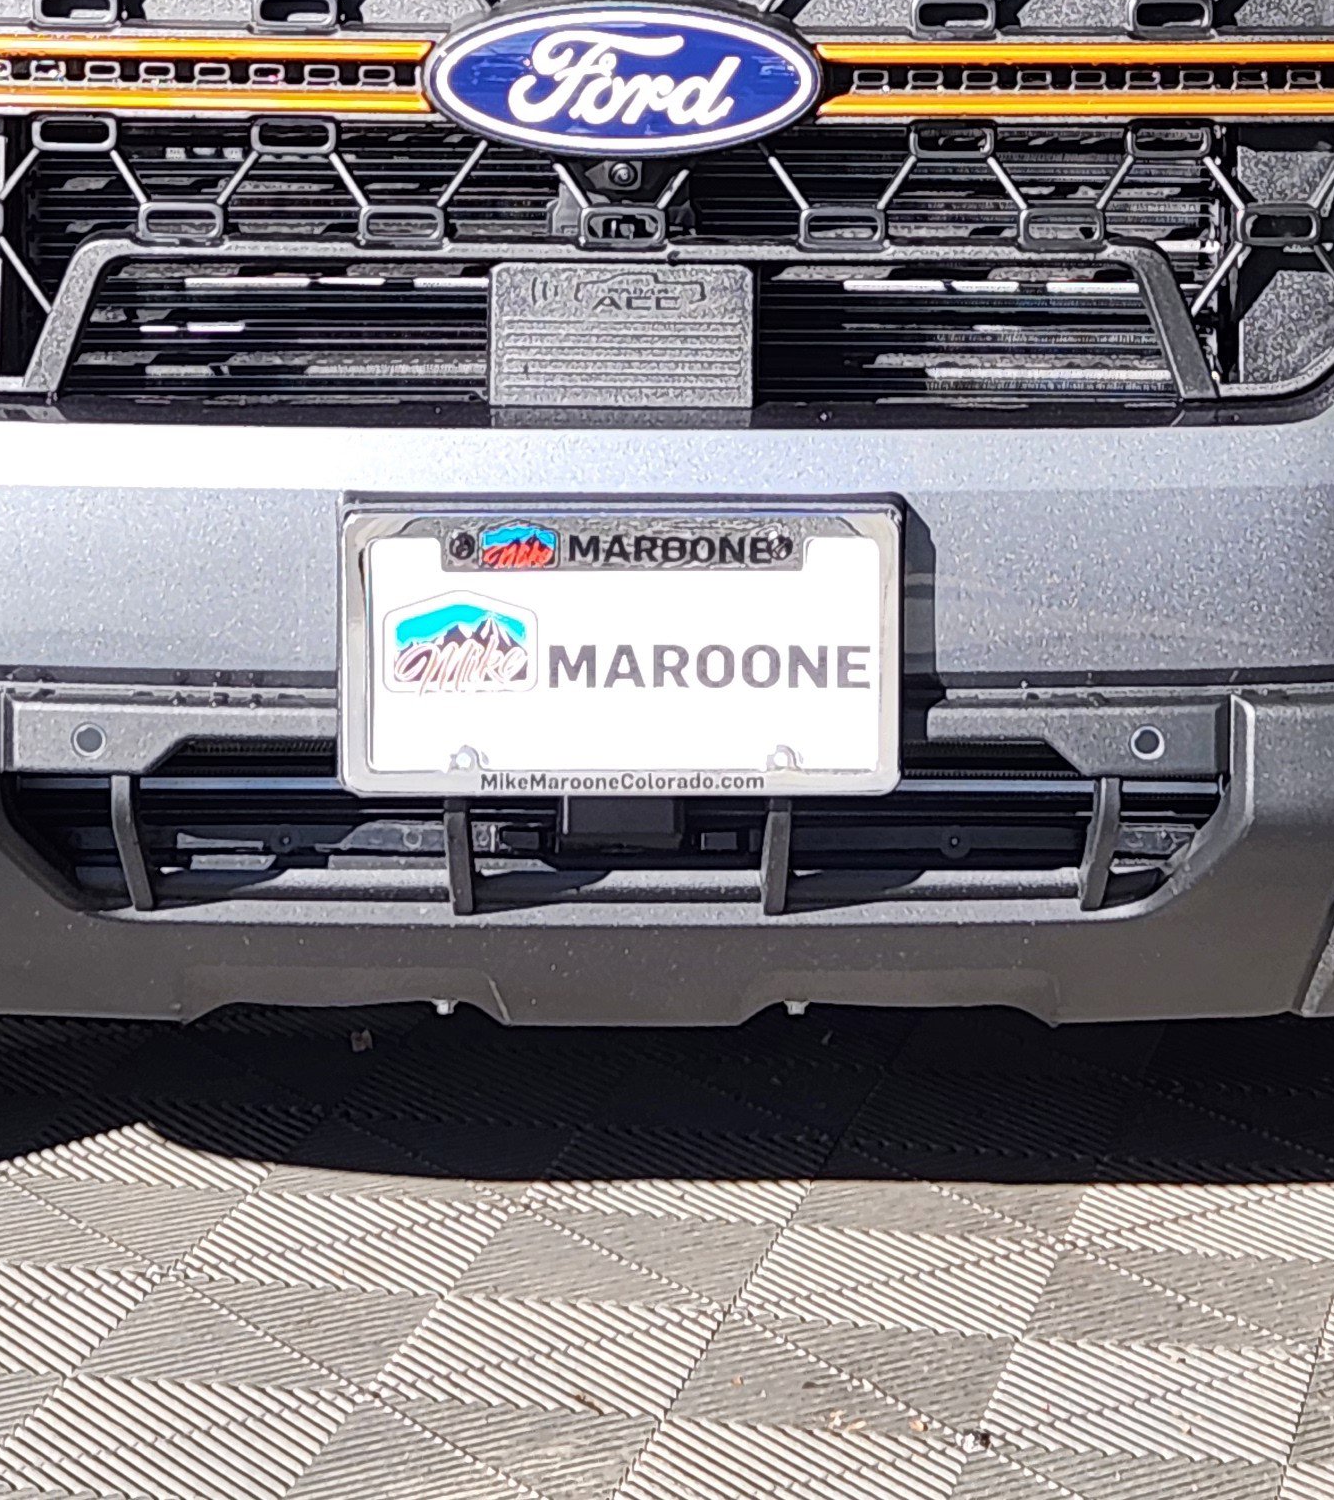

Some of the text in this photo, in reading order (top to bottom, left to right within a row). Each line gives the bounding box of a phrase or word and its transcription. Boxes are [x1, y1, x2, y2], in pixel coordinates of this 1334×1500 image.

[508, 30, 742, 126] Ford
[592, 296, 681, 311] ACC
[568, 534, 772, 564] MAROONE
[394, 633, 871, 697] Mike MAROONE
[480, 772, 766, 791] MikeMarooneColorado.com
